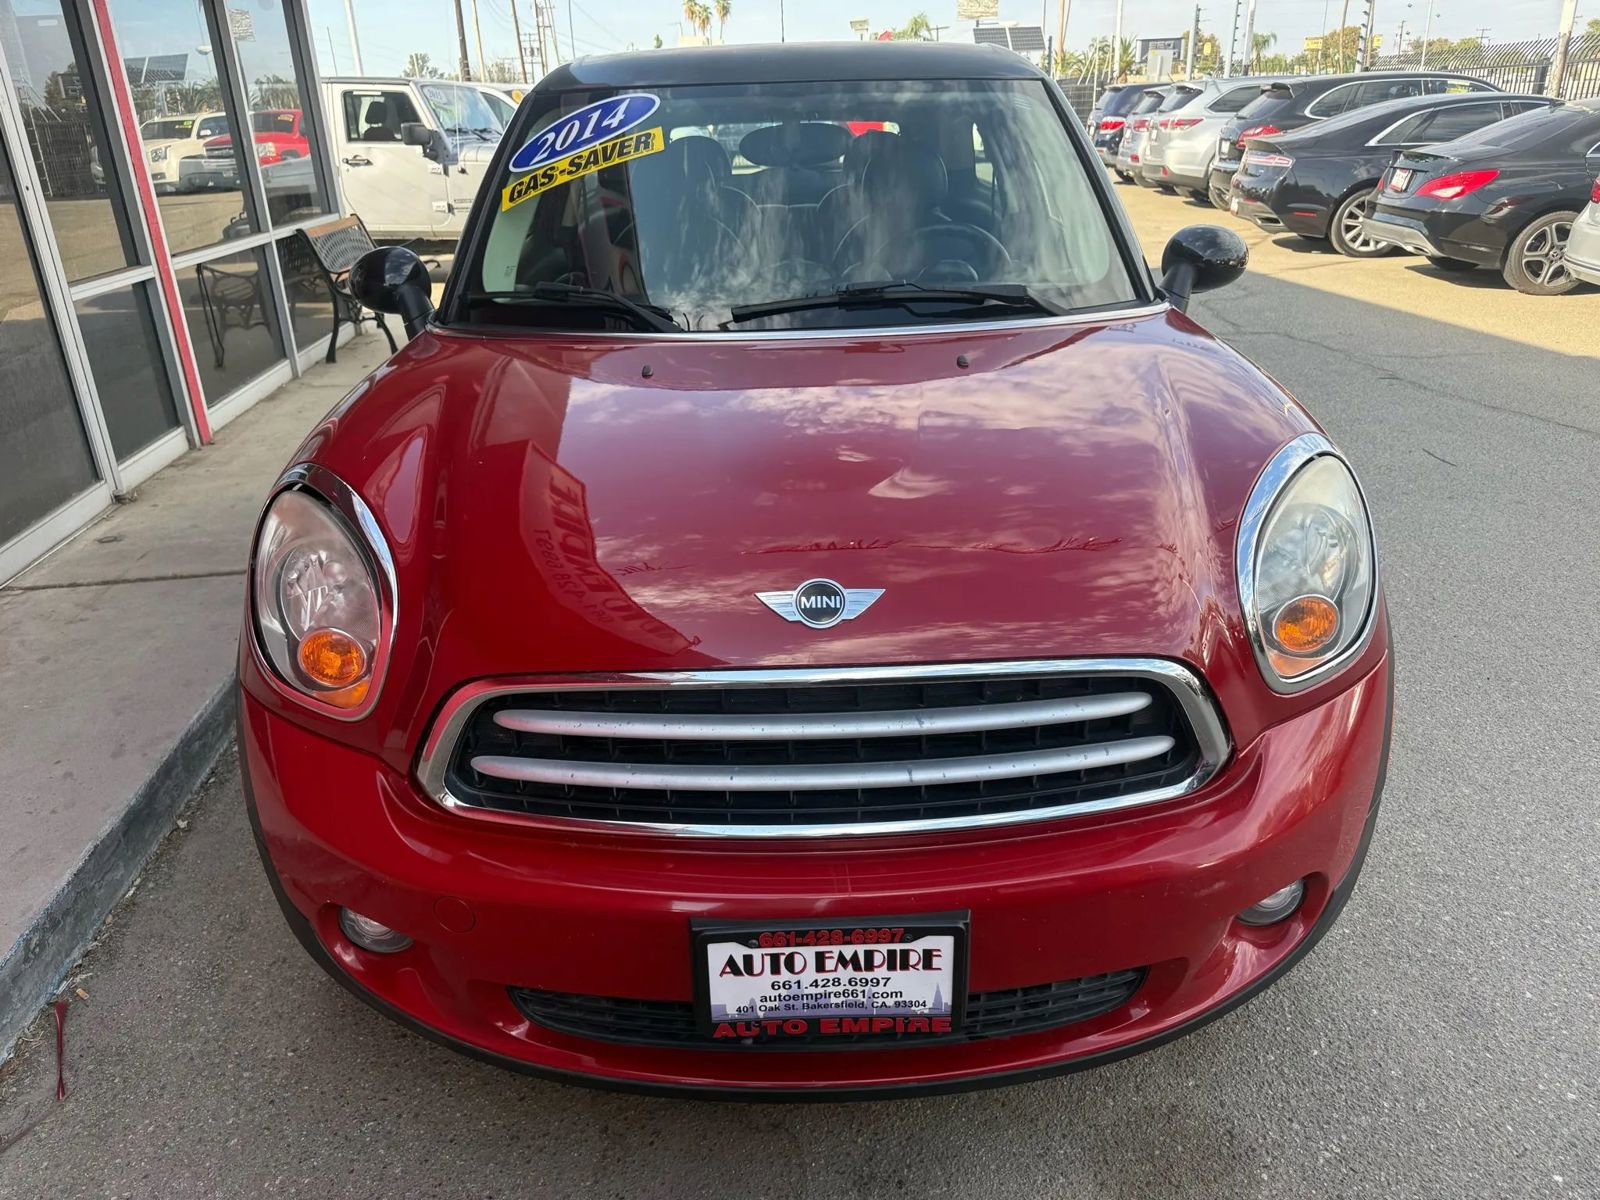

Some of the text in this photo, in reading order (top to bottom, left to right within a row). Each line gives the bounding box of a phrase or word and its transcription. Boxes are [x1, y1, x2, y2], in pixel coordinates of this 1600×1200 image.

[529, 98, 631, 166] 2014
[508, 132, 656, 203] GAS-SAVER
[800, 595, 841, 609] MINI
[758, 928, 905, 948] 661-428-6997
[719, 949, 942, 978] AUTO EMPIRE
[770, 977, 892, 991] 661.428.6997
[759, 988, 903, 1004] autoempire661.com
[735, 1004, 755, 1014] 401
[758, 1003, 781, 1012] Oak
[784, 1002, 799, 1011] St.
[894, 1000, 927, 1009] 93304
[713, 1017, 952, 1039] AUTO EMPIRE
